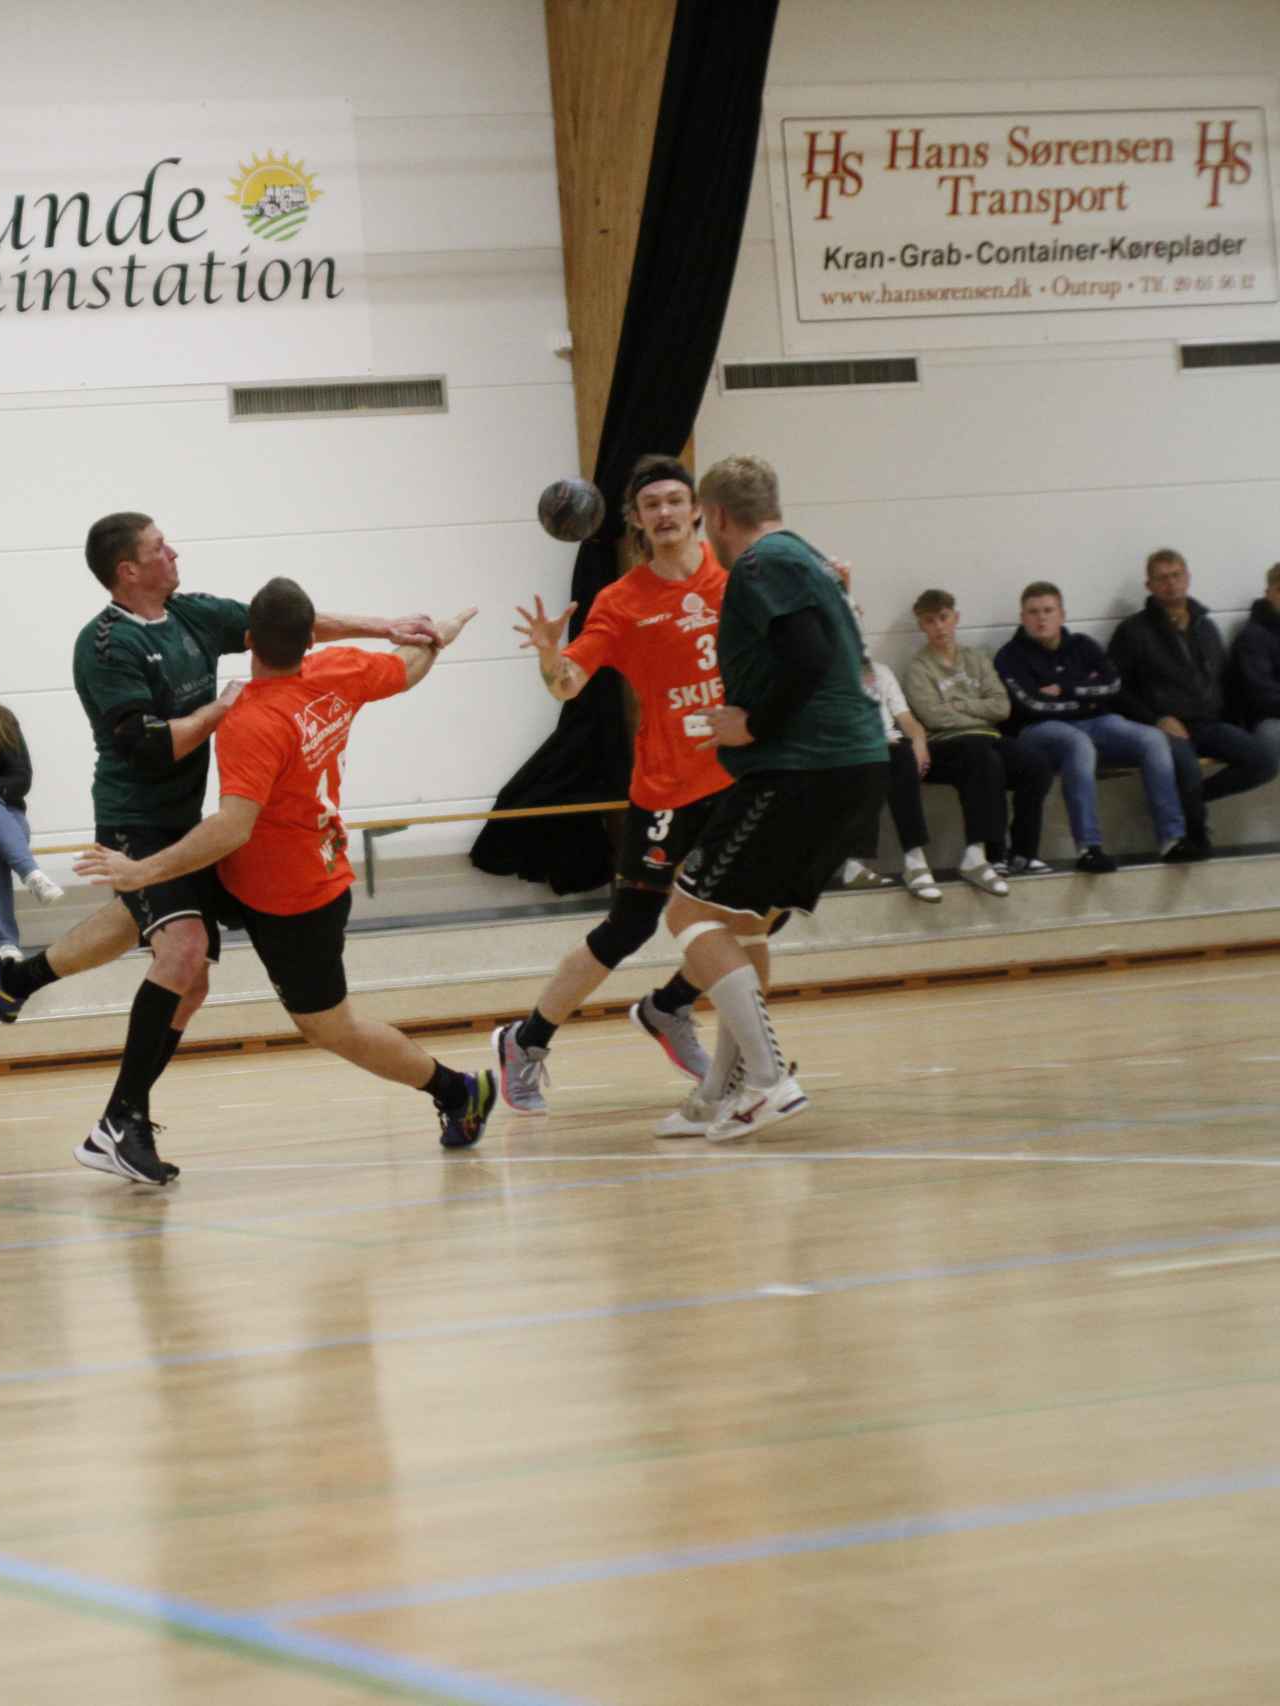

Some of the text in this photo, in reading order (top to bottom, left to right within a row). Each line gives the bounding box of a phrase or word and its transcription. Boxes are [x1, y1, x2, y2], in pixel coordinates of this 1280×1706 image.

[884, 125, 1174, 171] Hans Sørensen
[937, 173, 1129, 225] Transport
[1052, 275, 1122, 299] Outrup
[695, 633, 719, 671] 3
[668, 676, 726, 710] SKJE
[647, 808, 674, 841] 3
